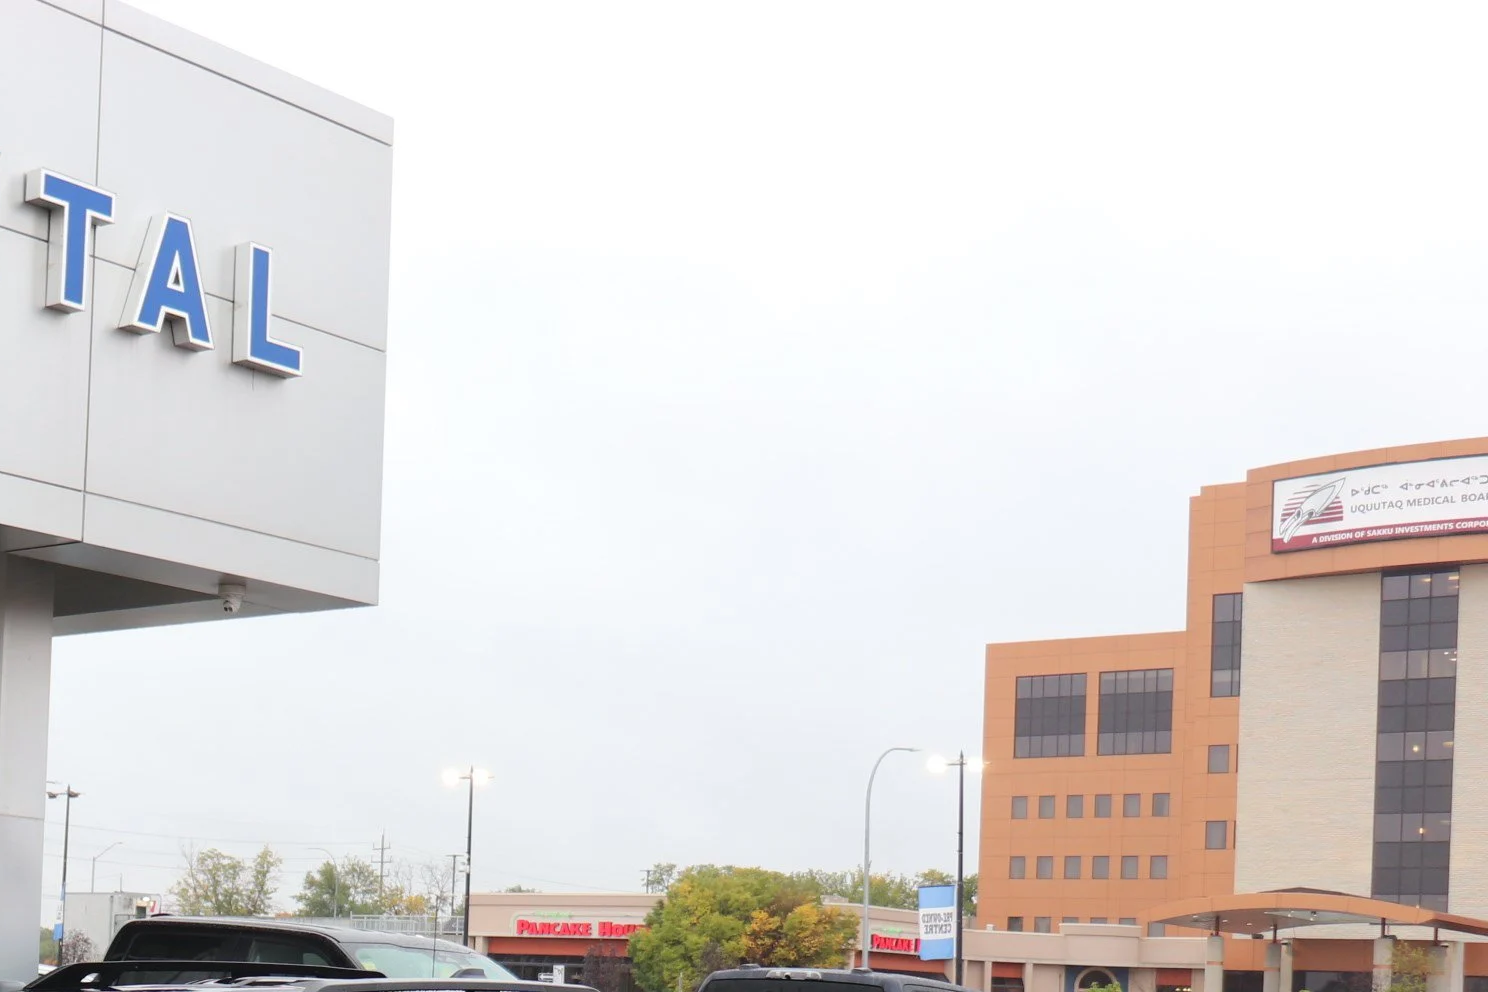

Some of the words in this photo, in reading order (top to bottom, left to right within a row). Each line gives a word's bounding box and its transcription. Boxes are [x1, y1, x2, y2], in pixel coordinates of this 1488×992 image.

[1350, 499, 1404, 514] UQUUTAQ
[1406, 495, 1457, 507] MEDICAL
[1461, 492, 1488, 503] BOA
[1312, 536, 1318, 544] A
[1319, 532, 1353, 543] DIVISION
[1355, 530, 1365, 539] OF
[1366, 527, 1394, 537] SAKKU
[1395, 521, 1454, 535] INVESTMENTS
[1455, 519, 1488, 530] CORPO
[517, 919, 592, 936] PANCAKE
[871, 933, 915, 952] PANCAKE
